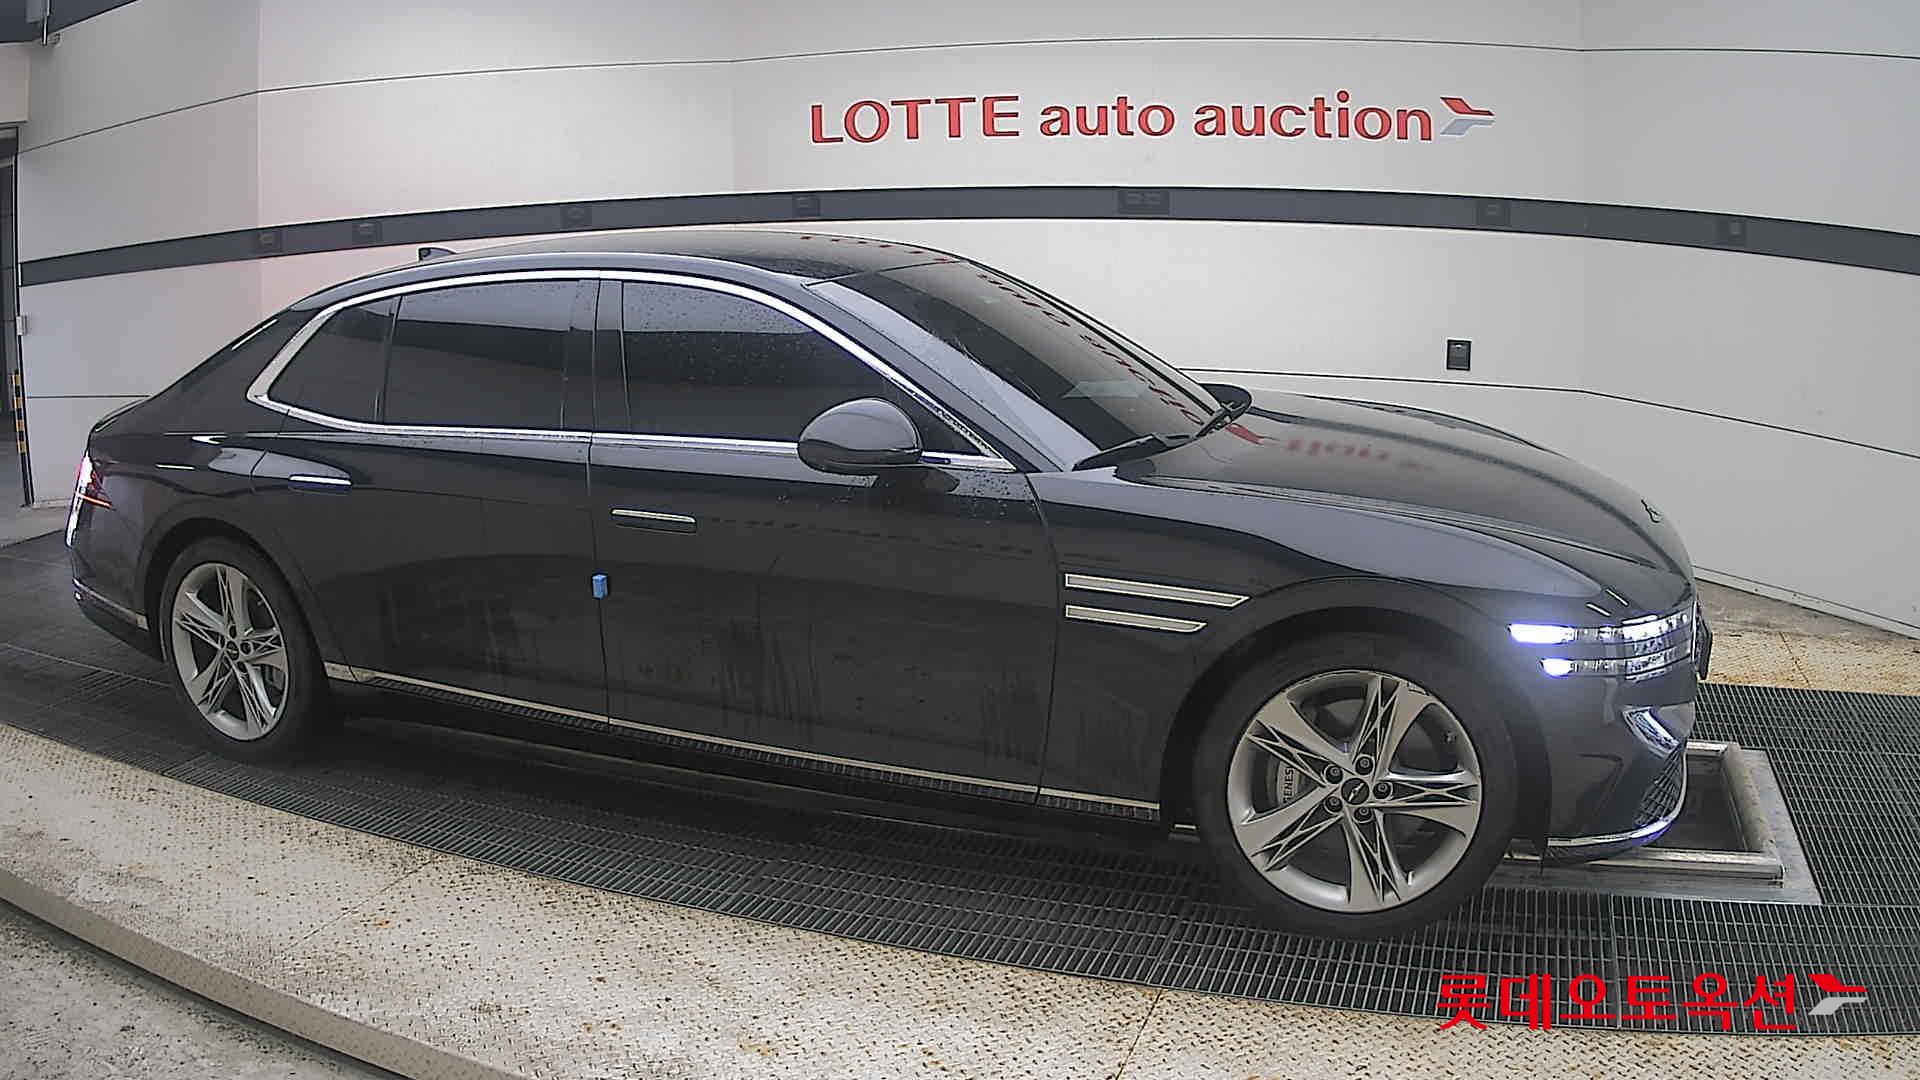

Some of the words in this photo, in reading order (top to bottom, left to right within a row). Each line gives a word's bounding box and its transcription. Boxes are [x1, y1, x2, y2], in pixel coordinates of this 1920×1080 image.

[810, 96, 1018, 144] LOTTE
[1038, 95, 1177, 137] auto
[1193, 90, 1435, 142] auction
